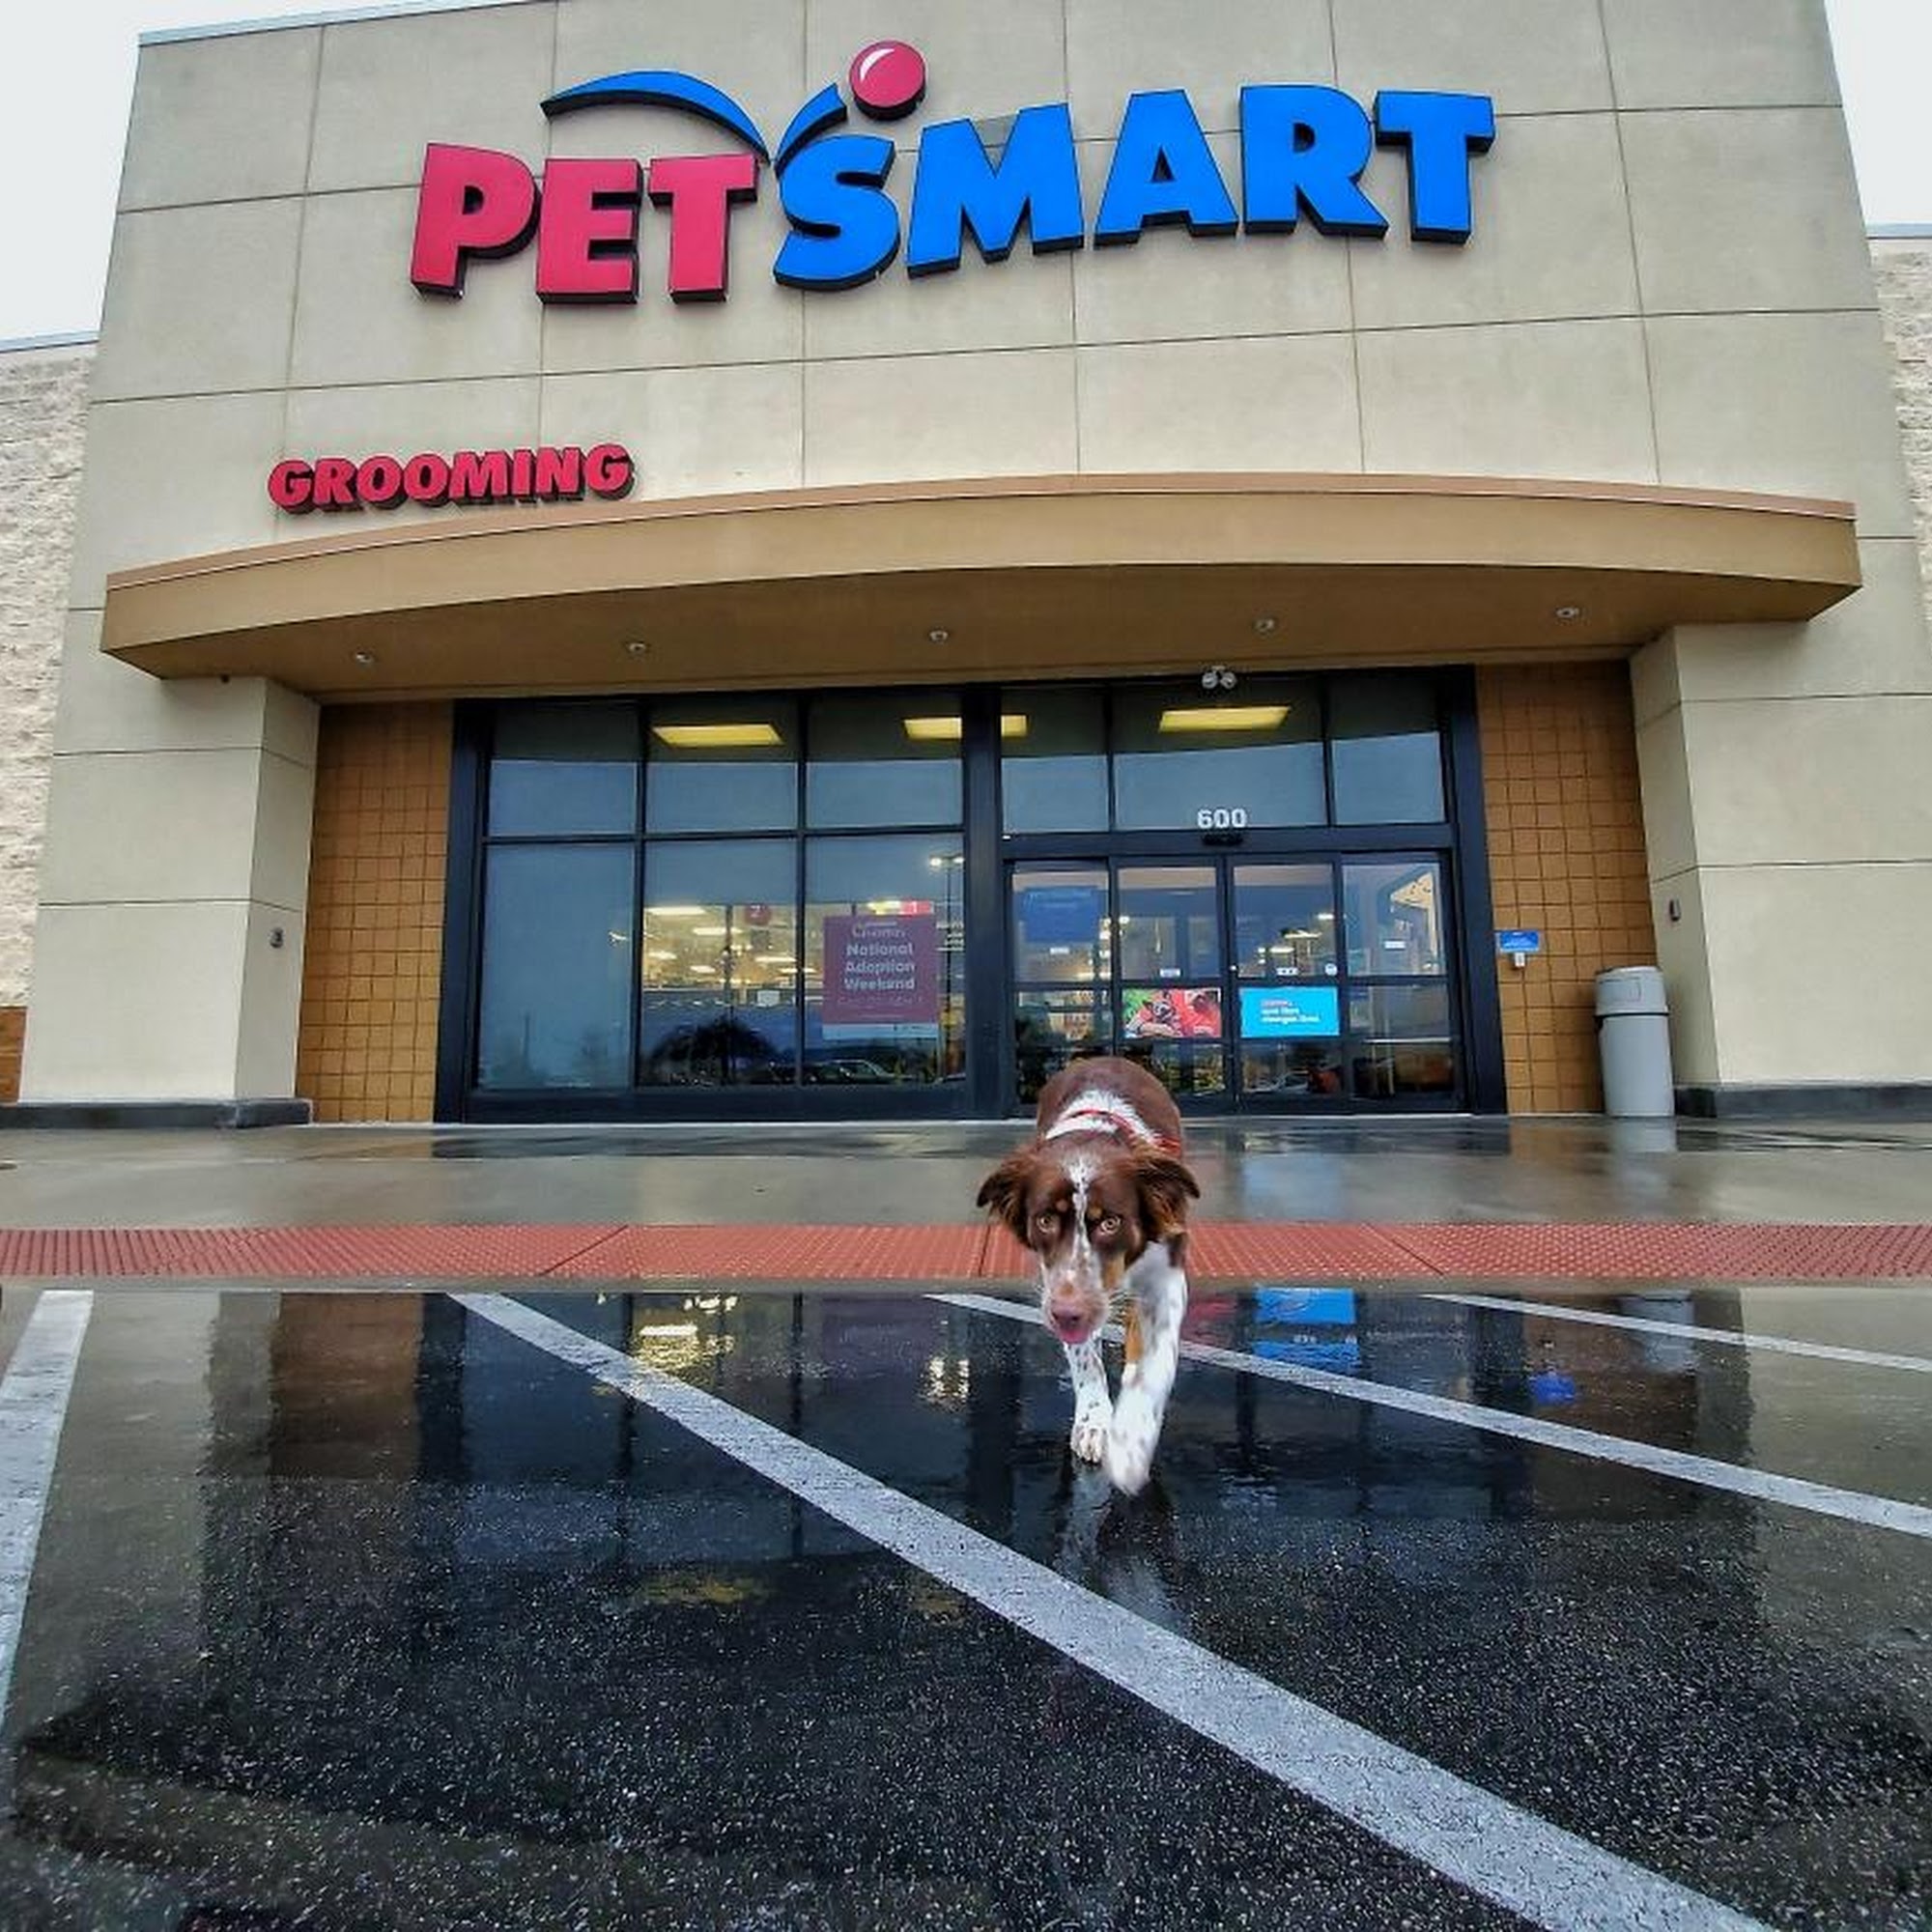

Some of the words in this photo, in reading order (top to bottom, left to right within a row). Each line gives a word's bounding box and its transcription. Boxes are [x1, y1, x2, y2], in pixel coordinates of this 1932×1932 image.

[409, 83, 1496, 304] PETSMART
[268, 443, 636, 514] GROOMING
[1197, 809, 1247, 829] 600
[845, 942, 914, 956] National
[844, 957, 916, 975] Adoption
[843, 976, 916, 990] Weekend
